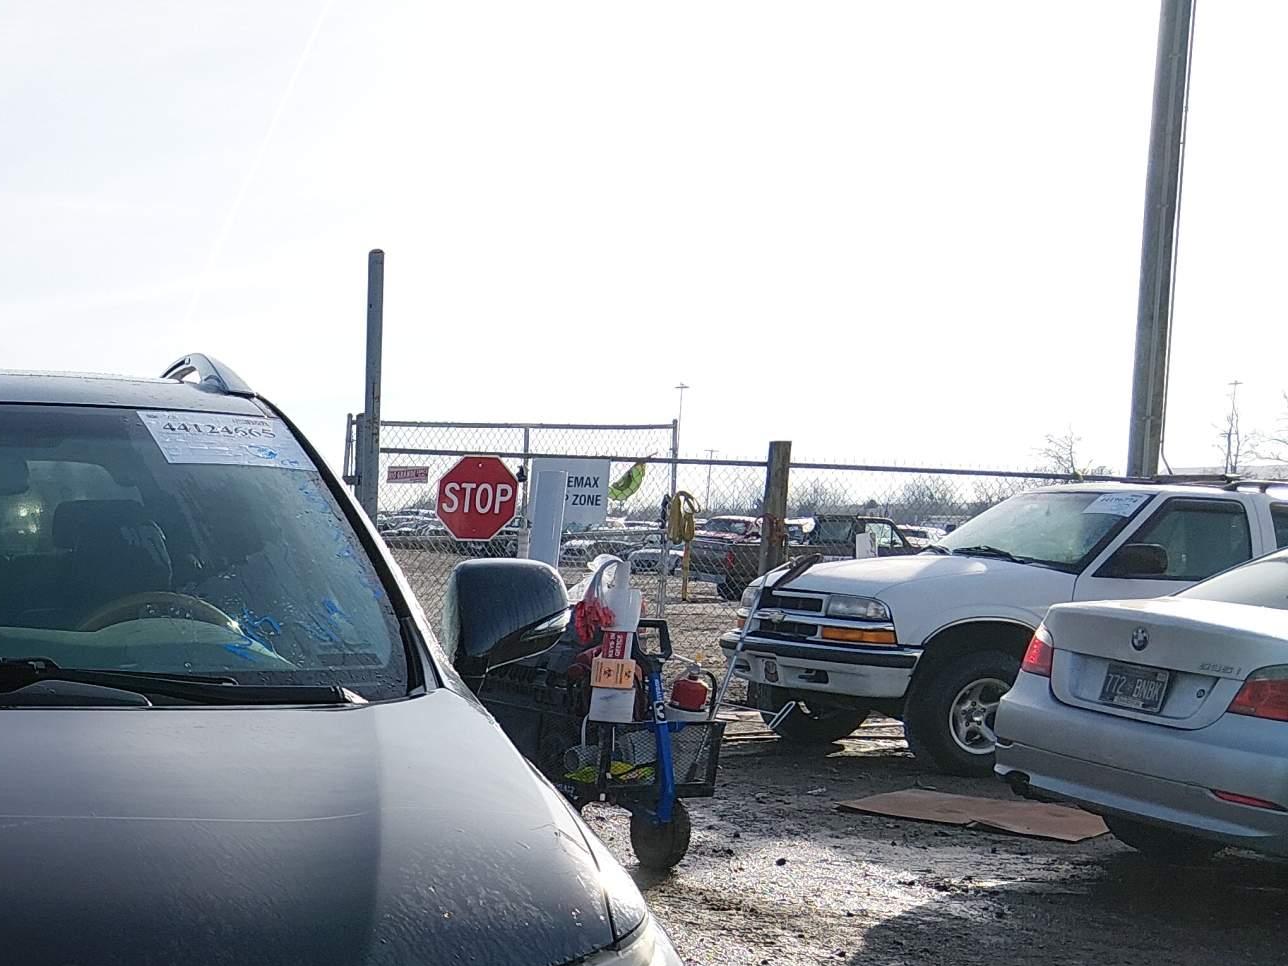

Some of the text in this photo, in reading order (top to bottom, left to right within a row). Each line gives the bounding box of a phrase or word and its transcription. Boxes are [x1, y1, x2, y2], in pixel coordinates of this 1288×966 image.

[162, 422, 276, 439] 44124665
[442, 482, 513, 514] STOP
[572, 494, 601, 506] ZONE
[1105, 673, 1127, 695] 772
